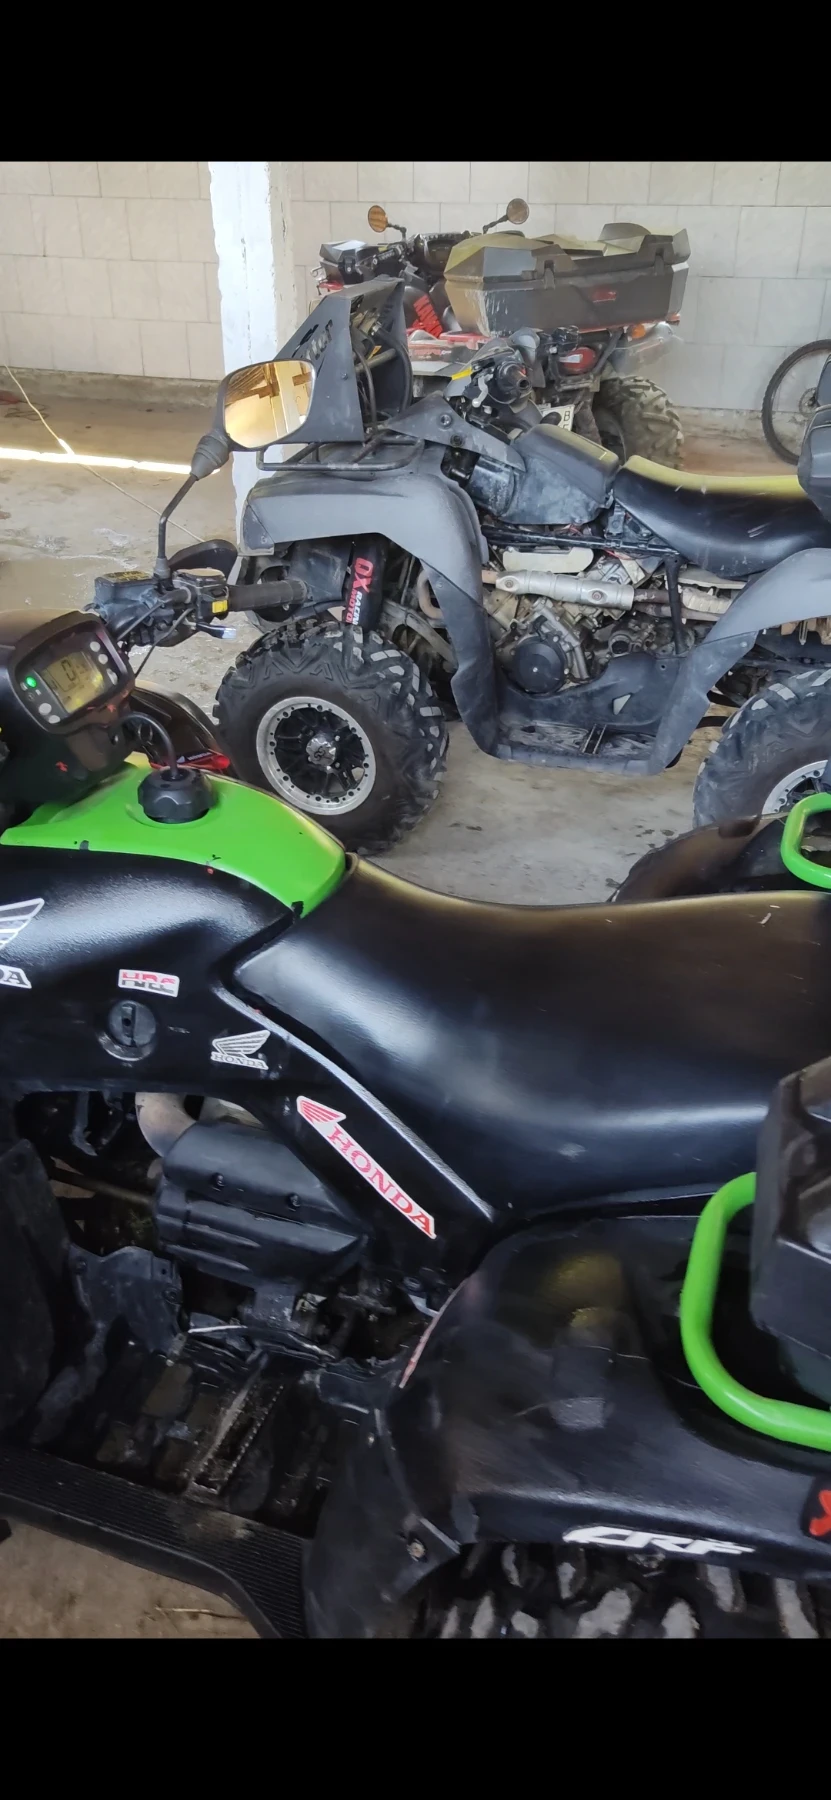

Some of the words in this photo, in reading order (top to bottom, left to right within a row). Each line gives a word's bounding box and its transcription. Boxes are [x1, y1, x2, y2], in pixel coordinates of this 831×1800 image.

[353, 557, 374, 593] OX
[212, 1052, 267, 1069] HONDA
[327, 1125, 433, 1237] HONDA
[563, 1525, 756, 1555] CRF
